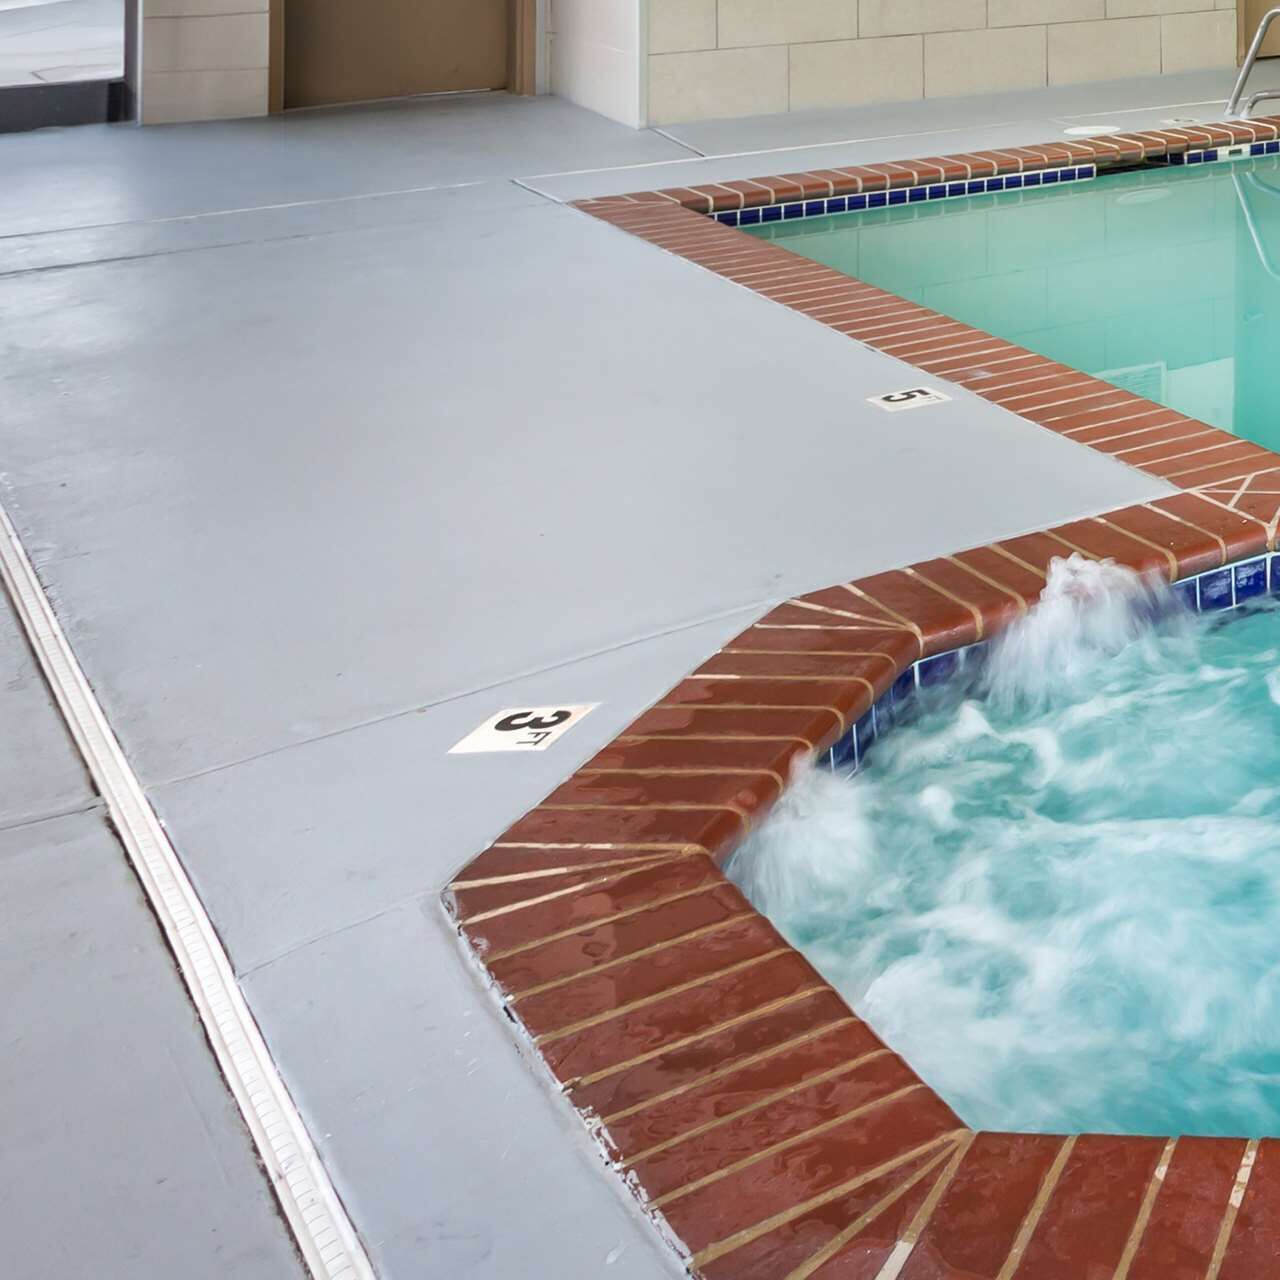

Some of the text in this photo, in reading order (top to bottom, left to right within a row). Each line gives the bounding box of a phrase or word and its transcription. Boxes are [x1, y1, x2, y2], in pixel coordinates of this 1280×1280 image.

[881, 388, 931, 403] 5
[494, 710, 572, 746] 3 FT
